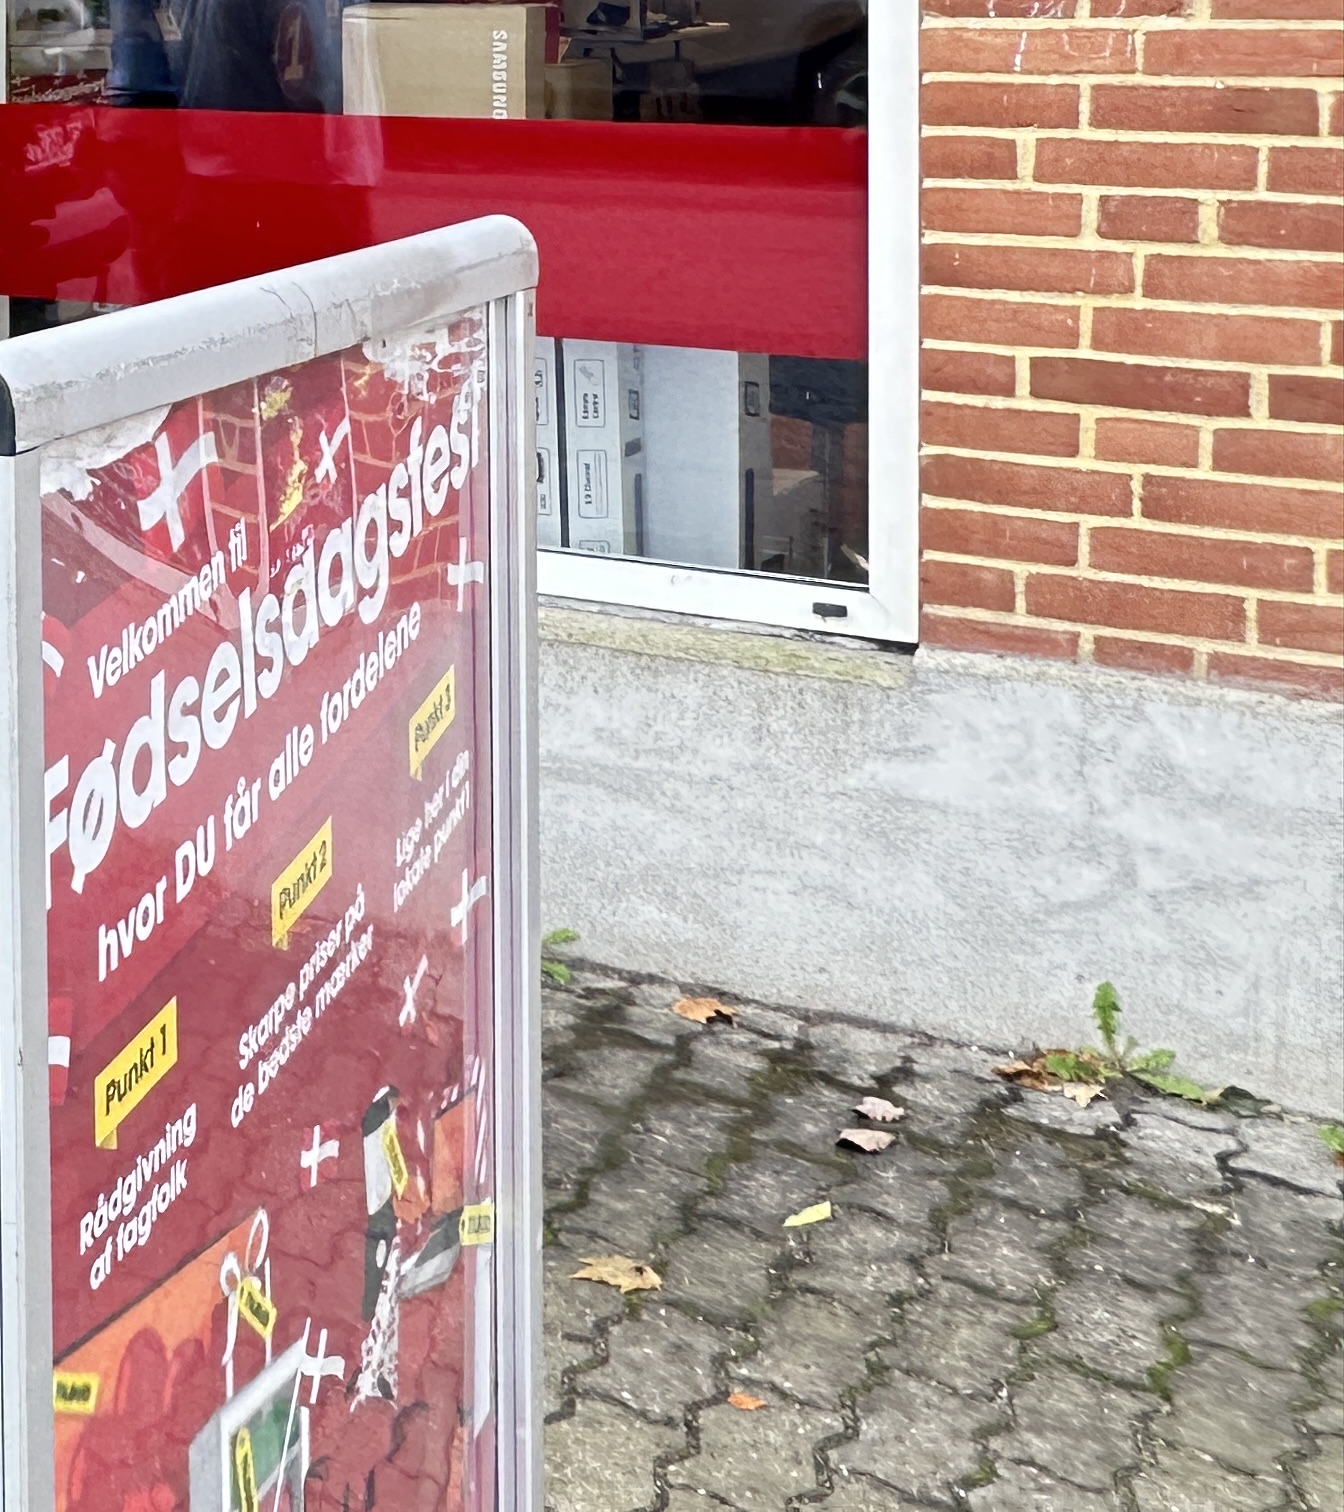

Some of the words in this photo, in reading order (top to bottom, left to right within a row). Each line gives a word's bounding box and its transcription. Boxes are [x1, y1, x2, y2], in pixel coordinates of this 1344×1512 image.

[87, 550, 226, 698] Velkommen
[98, 876, 168, 982] hvor
[175, 815, 215, 903] DU
[224, 776, 261, 851] får
[269, 723, 315, 801] alle
[320, 601, 421, 744] fordelene
[279, 852, 318, 920] Punkt
[319, 840, 328, 873] 2
[230, 1081, 255, 1128] de
[258, 1005, 313, 1095] bedste
[315, 924, 374, 1019] mærker
[239, 982, 296, 1071] Skarpe
[299, 919, 343, 1002] priser
[344, 882, 366, 944] på
[105, 1036, 156, 1117] Punkt
[159, 1023, 167, 1056] 1
[79, 1102, 197, 1256] Rådgivning
[90, 1235, 115, 1290] af
[116, 1158, 188, 1262] fagfolk
